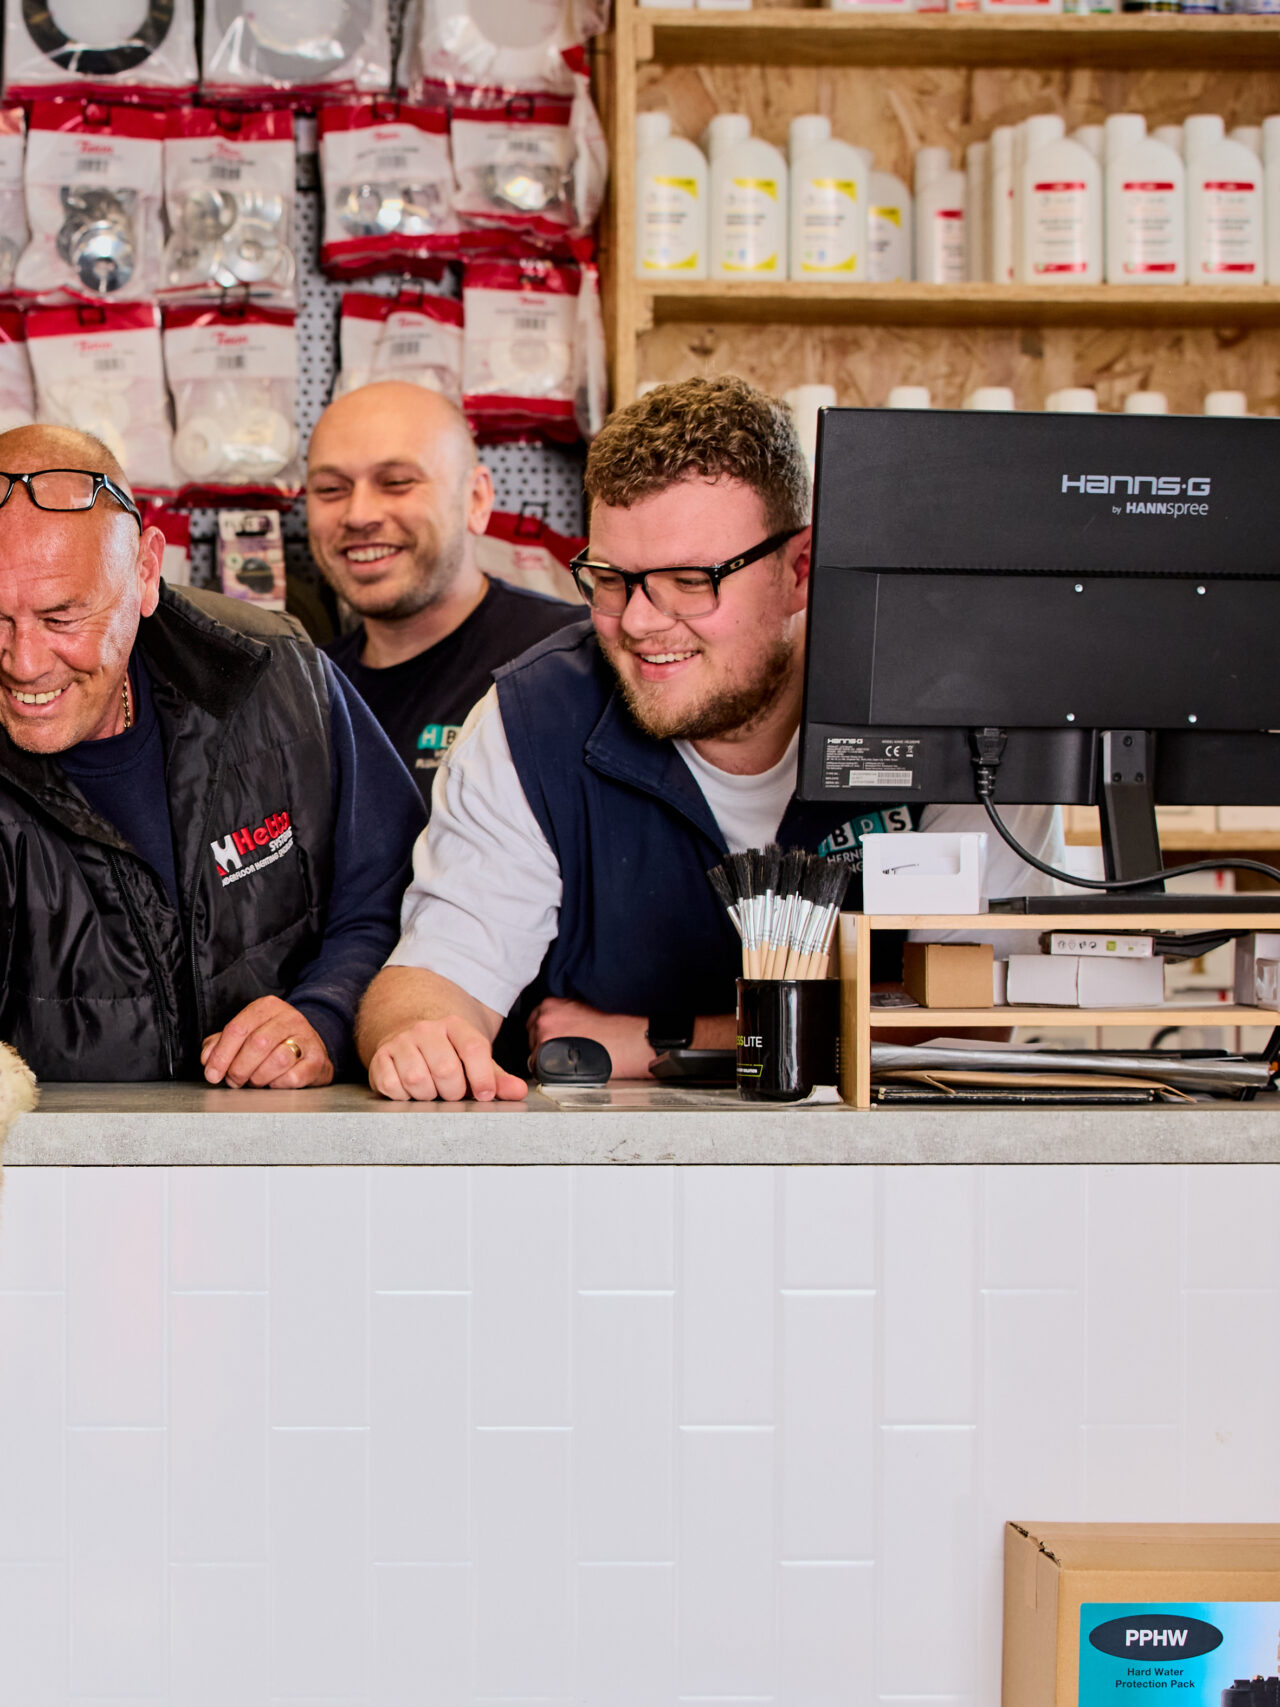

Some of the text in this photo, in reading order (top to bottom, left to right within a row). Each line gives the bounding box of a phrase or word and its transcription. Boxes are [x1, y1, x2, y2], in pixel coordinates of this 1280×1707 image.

[1111, 505, 1122, 515] by
[1125, 1629, 1189, 1647] PPHW
[1127, 1667, 1184, 1677] Hard Water
[1115, 1679, 1195, 1689] Protection Pack
